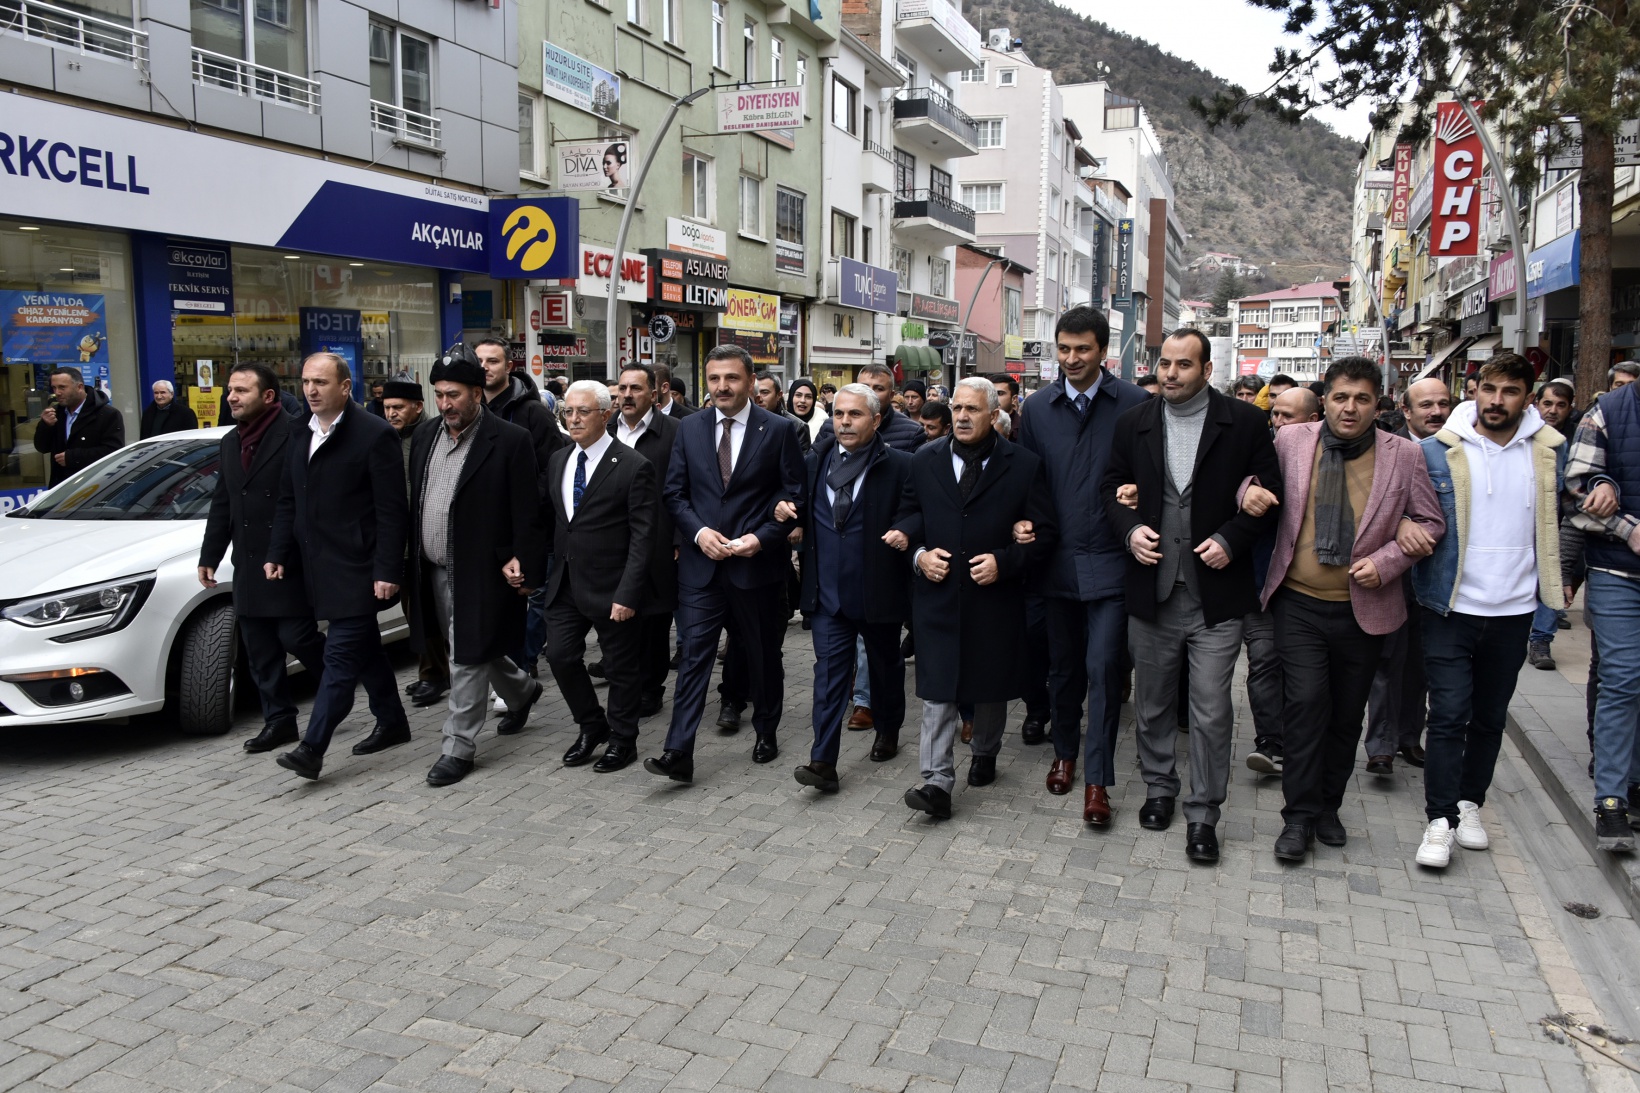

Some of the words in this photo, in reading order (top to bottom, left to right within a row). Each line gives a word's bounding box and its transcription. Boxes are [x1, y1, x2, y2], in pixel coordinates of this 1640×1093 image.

[545, 47, 576, 71] HUZURLU
[577, 61, 591, 78] SİTE
[737, 91, 800, 111] DİYETİSYEN
[766, 111, 794, 120] BİLGİN
[723, 122, 755, 130] BESLENME
[756, 119, 799, 128] DANIŞMANLIĞI
[561, 148, 602, 157] SALON
[1393, 150, 1409, 222] KUAFÖR
[443, 191, 457, 202] SATIŞ
[457, 194, 478, 205] NOKTASI
[1439, 149, 1474, 250] CHP
[411, 221, 483, 251] AKÇAYLAR
[584, 250, 646, 283] ECZANE
[663, 260, 682, 269] TELEFON
[686, 259, 728, 280] ASLANER
[169, 283, 200, 293] TEKNİK
[201, 285, 230, 295] SERVİS
[686, 283, 728, 308] İLETİŞİM
[22, 294, 50, 305] YENİ
[52, 296, 84, 307] YILDA
[663, 292, 682, 301] SERVİS
[18, 306, 44, 315] CİHAZ
[47, 307, 90, 317] YENİLEME
[26, 316, 83, 325] KAMPANYASI
